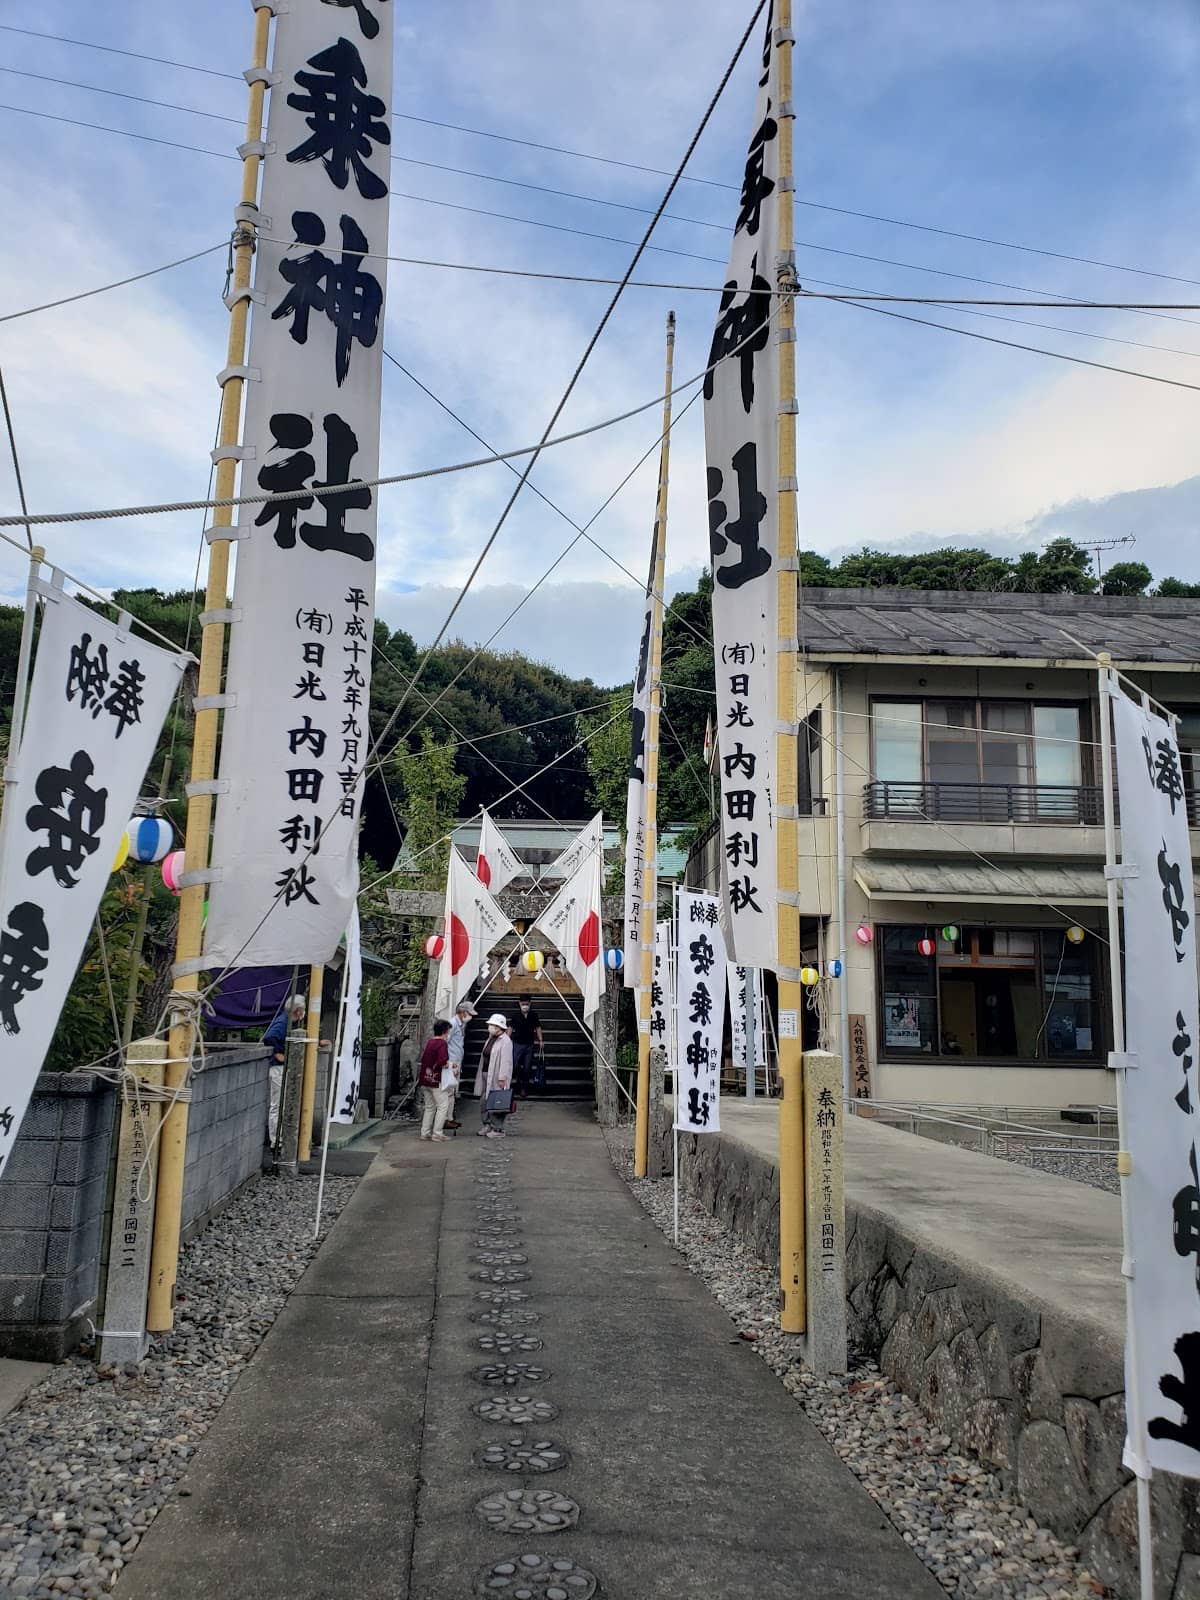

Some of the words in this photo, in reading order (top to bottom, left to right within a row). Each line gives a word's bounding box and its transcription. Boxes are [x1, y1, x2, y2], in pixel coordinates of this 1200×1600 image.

[255, 0, 391, 561] 乗神社
[337, 587, 369, 819] 平成十九年九月吉日
